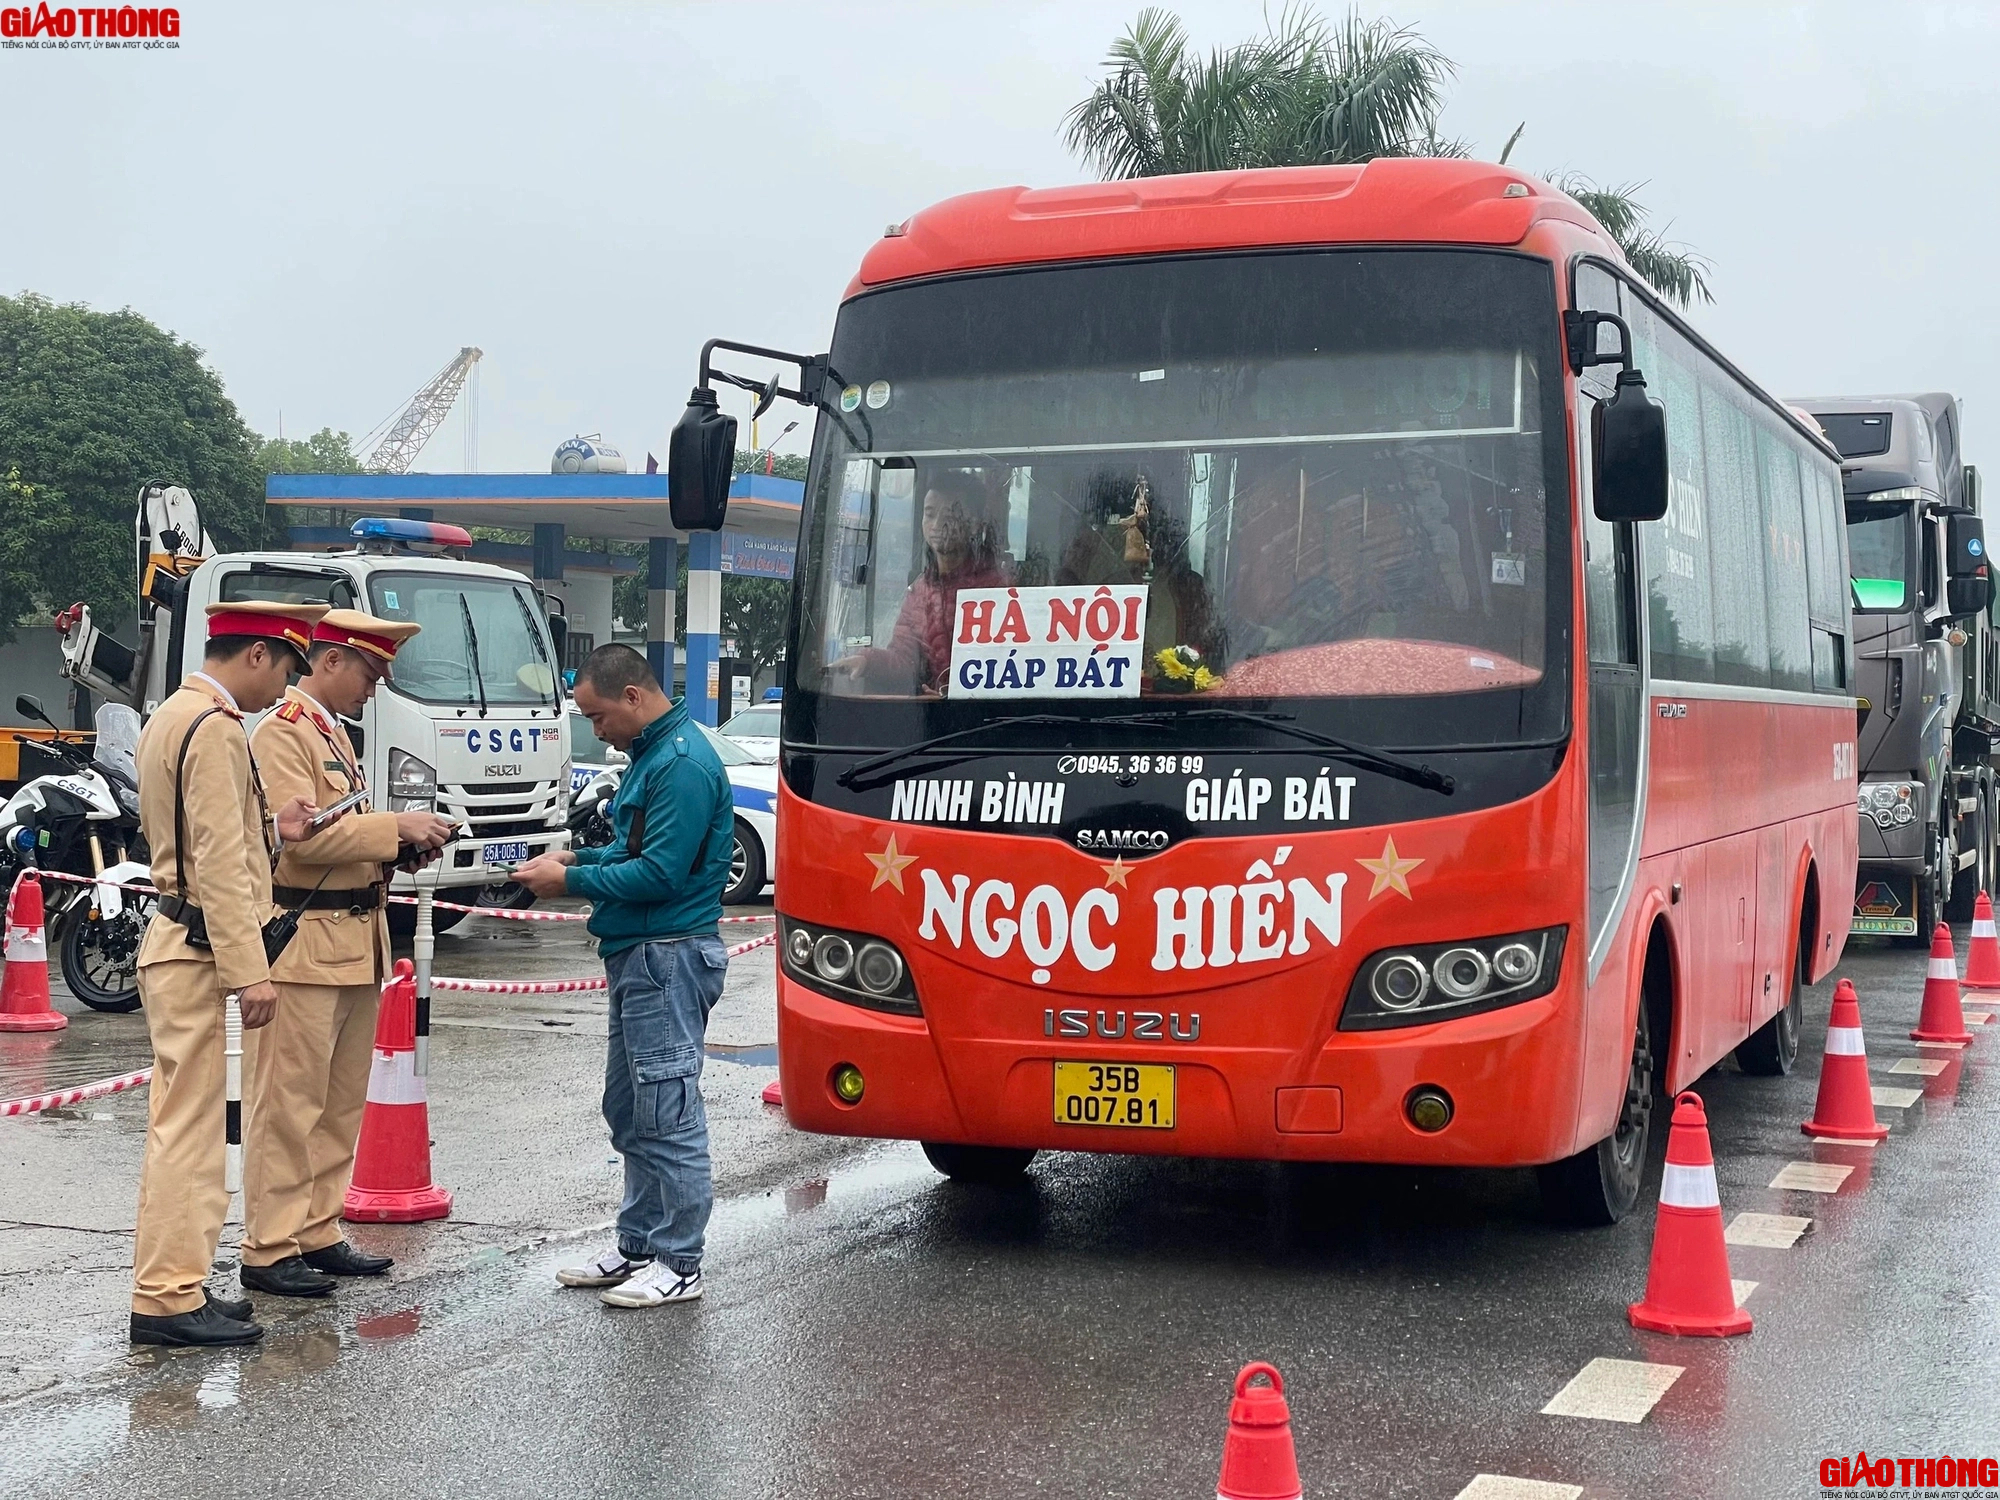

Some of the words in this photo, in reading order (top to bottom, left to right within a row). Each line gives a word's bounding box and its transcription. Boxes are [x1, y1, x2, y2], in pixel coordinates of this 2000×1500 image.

[957, 587, 1031, 644] HÀ
[1046, 586, 1142, 652] NỘI
[959, 649, 1046, 690] GIÁP
[1055, 648, 1130, 688] BÁT
[467, 728, 541, 753] CSGT
[484, 764, 521, 777] ISUZU
[1077, 755, 1124, 774] 0945.
[1129, 755, 1151, 774] 36
[1154, 755, 1177, 774] 36
[1181, 755, 1203, 774] 99
[57, 779, 98, 799] CSGT
[890, 780, 974, 822] NINH
[980, 771, 1066, 825] BÌNH
[1185, 768, 1272, 822] GIÁP
[1284, 766, 1357, 821] BÁT
[484, 843, 527, 861] 35A-005.16
[1077, 829, 1169, 850] SAMCO
[918, 868, 1120, 984] NGỌC
[1151, 845, 1349, 971] HIẾN
[1045, 1009, 1200, 1041] ISUZU
[1088, 1066, 1140, 1093] 35B
[1066, 1095, 1158, 1125] 007.81
